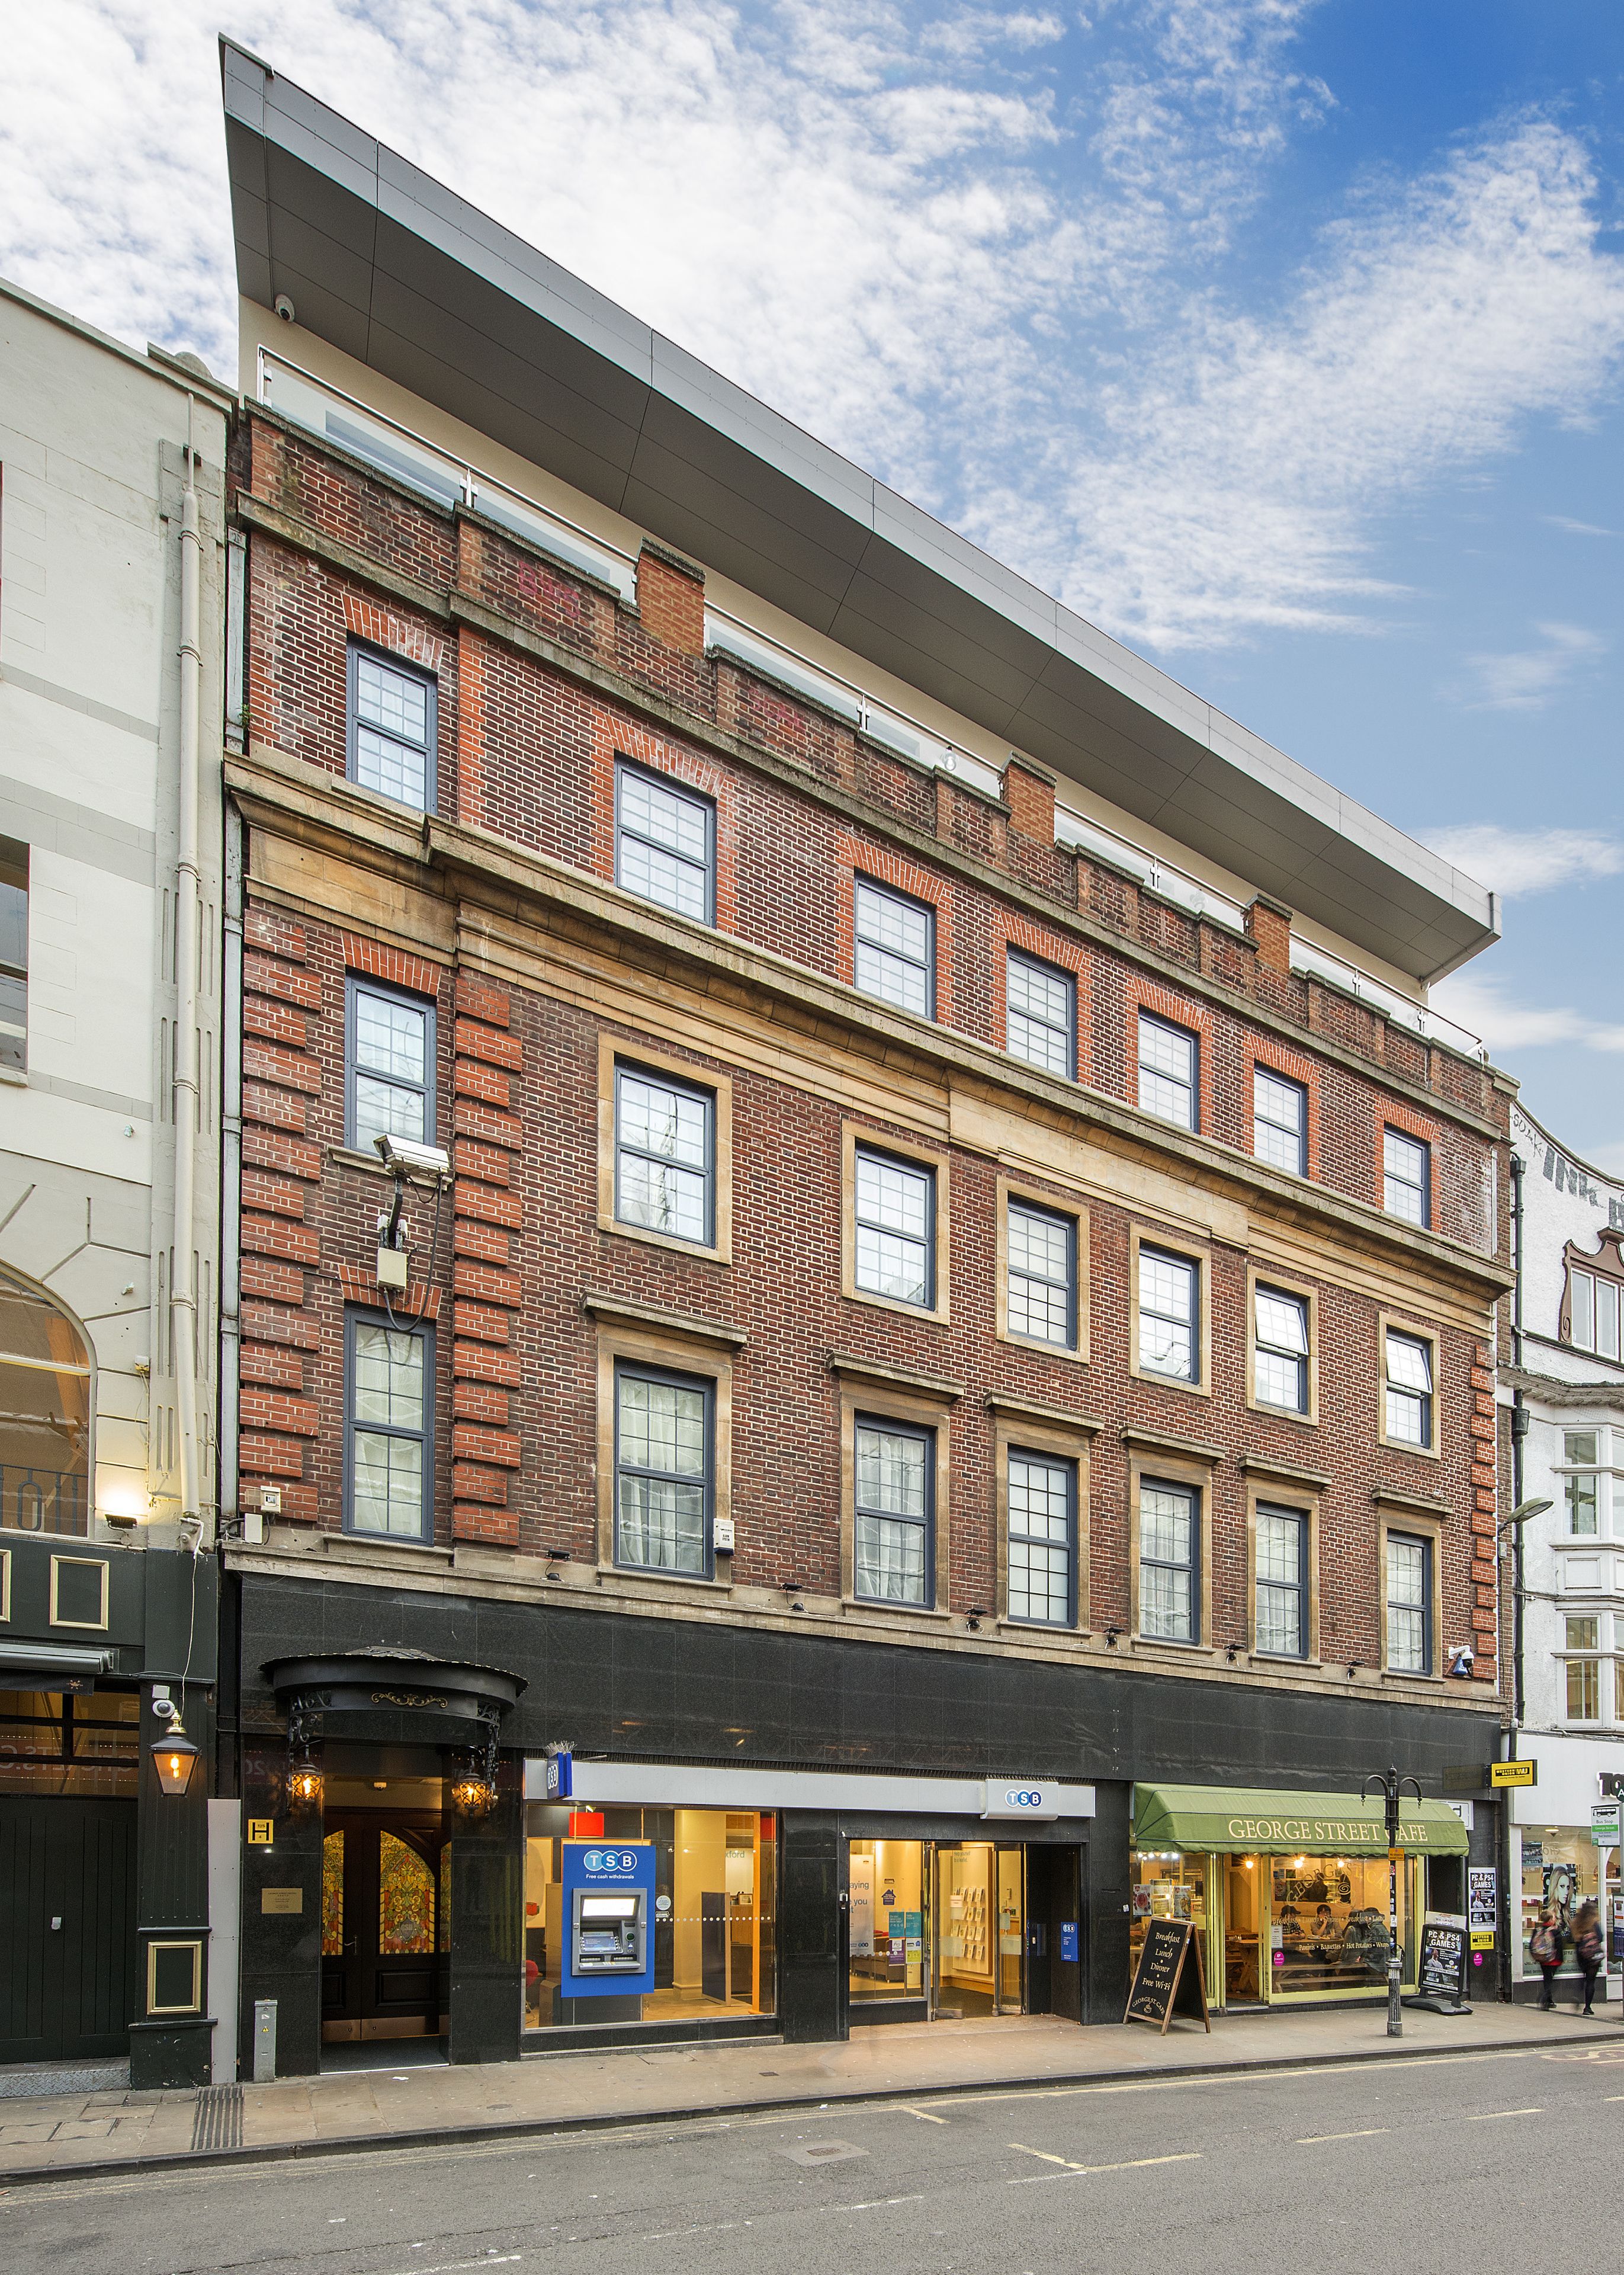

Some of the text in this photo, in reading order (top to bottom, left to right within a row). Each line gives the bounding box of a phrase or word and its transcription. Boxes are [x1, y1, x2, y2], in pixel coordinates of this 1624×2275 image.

[1599, 1772, 1624, 1796] TO
[1009, 1792, 1040, 1805] TSB
[1228, 1819, 1312, 1841] GEORGE
[1315, 1822, 1380, 1842] STREET
[725, 1850, 745, 1859] xford
[589, 1854, 633, 1868] TSB
[850, 1880, 869, 1890] aying
[853, 1899, 868, 1908] you
[1346, 1912, 1368, 1924] Breakfast
[1155, 1931, 1180, 1944] Breakfast
[1428, 1930, 1460, 1942] PC & PS4
[1320, 1943, 1341, 1952] Baguettes
[1375, 1941, 1389, 1950] Wraps
[1431, 1938, 1456, 1949] GAMES
[1155, 1948, 1173, 1959] Lunch
[1150, 1962, 1170, 1973] Dinner
[1142, 1977, 1171, 1991] Free Wi-Fi
[1132, 1997, 1151, 2007] GEORGE
[1156, 2002, 1166, 2015] CAFE
